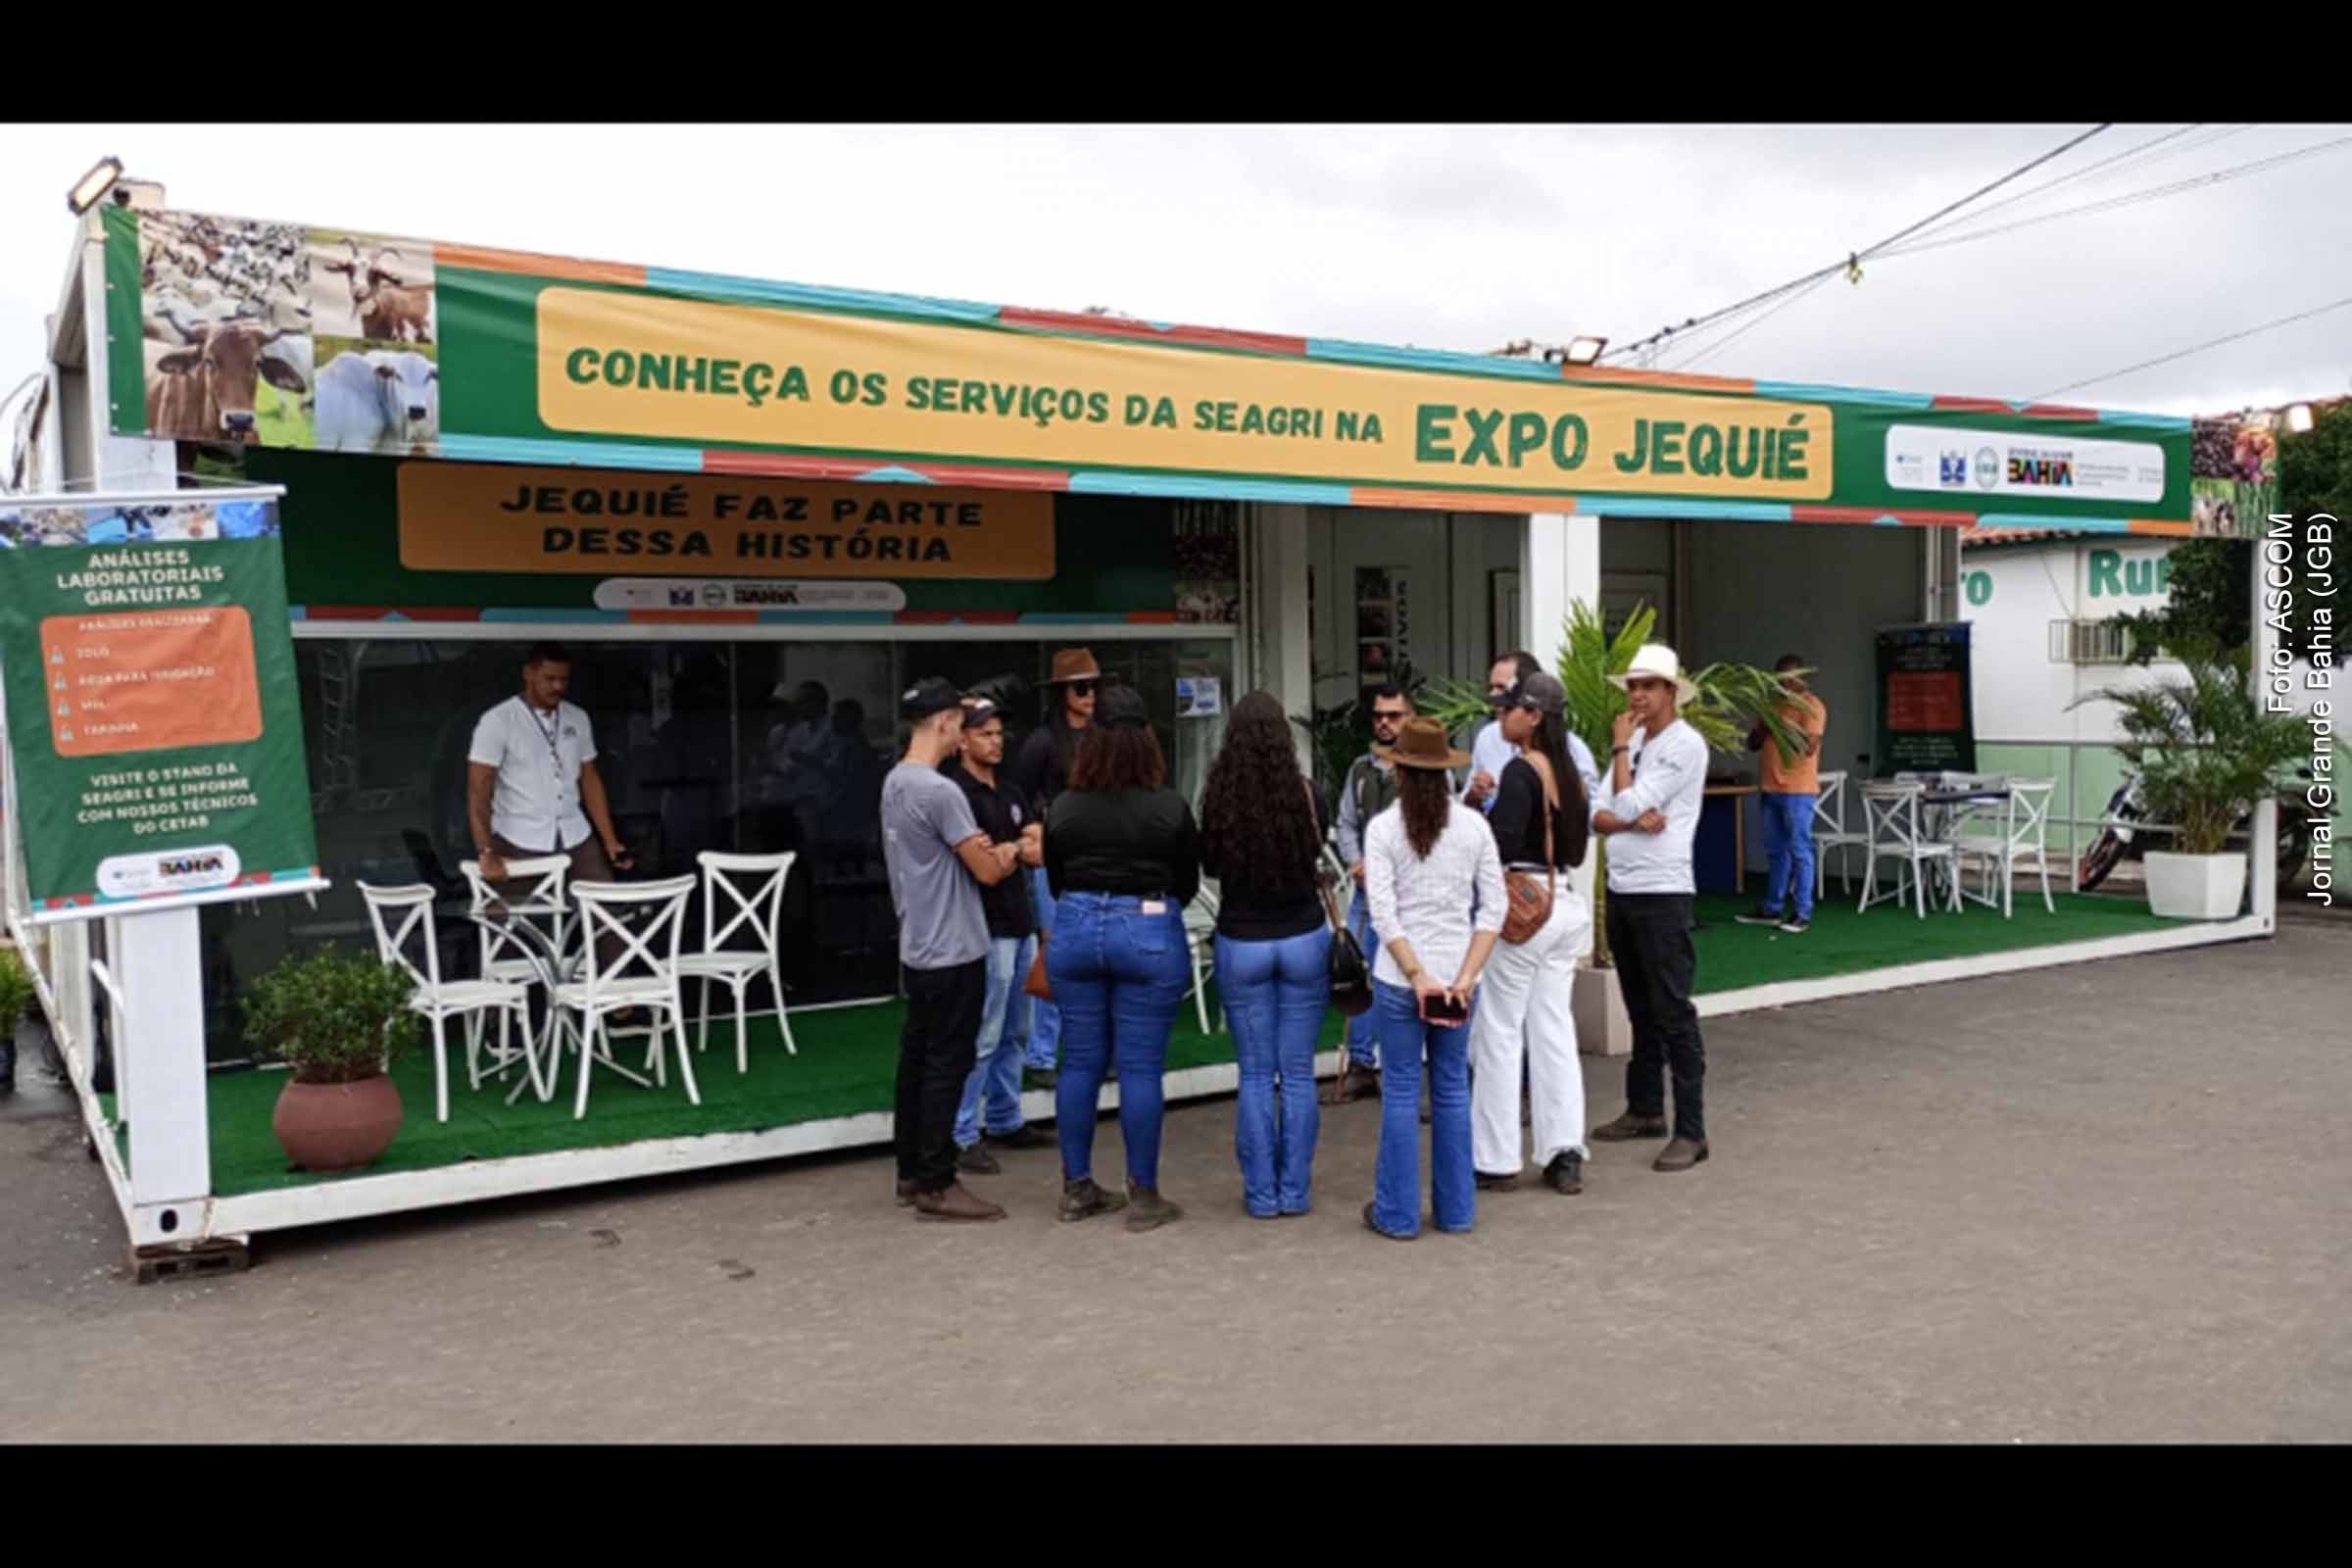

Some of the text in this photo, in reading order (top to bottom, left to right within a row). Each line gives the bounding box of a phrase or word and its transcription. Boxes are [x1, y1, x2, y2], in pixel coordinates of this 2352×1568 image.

[565, 346, 1810, 480] CONHEÇA OS SERVIÇOS DA SEAGRI NA EXPO JEQUIÉ
[2007, 458, 2074, 486] BAHIA
[500, 484, 983, 525] JEQUIÉ FAZ PARTE
[543, 526, 952, 562] DESSA HISTÓRIA
[88, 549, 190, 570] ANÁLISES
[57, 564, 224, 590] LABORATORIAIS
[1960, 568, 1993, 607] o
[84, 584, 202, 607] GRATUITAS
[91, 761, 238, 787] VISITE O STAND DA
[81, 777, 250, 805] SEAGRI E SE INFORME
[77, 792, 259, 823] COM NOSSOS TÉCNICOS
[133, 815, 210, 835] DO CETAB
